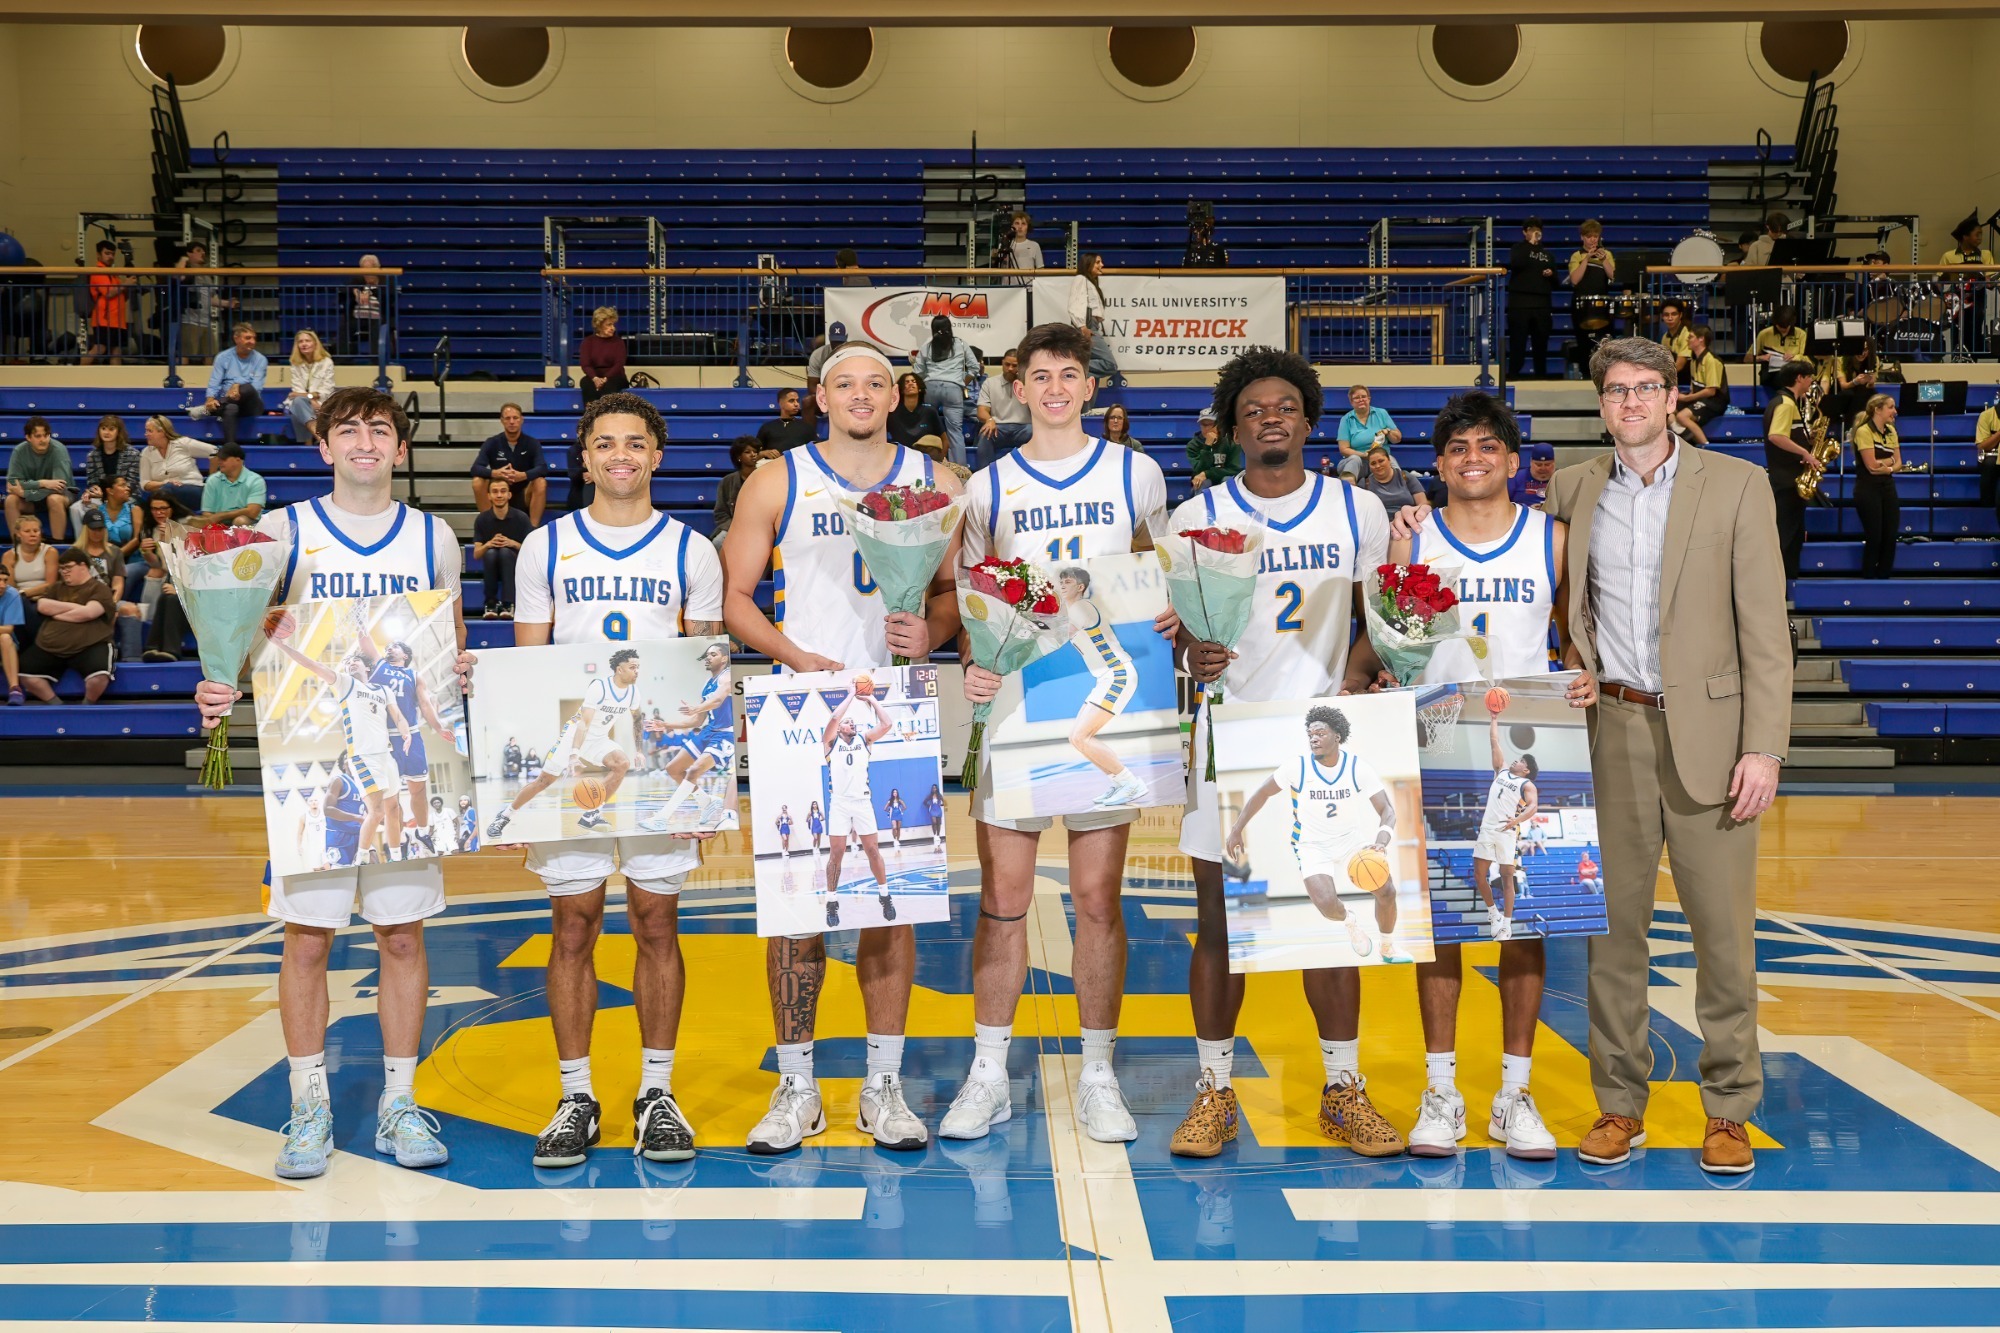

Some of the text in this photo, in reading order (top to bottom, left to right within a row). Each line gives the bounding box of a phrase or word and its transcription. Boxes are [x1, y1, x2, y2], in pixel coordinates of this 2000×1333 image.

[919, 291, 989, 319] MCA
[1104, 297, 1248, 308] ULL SAIL UNIVERSITY'S
[1133, 319, 1249, 338] PATRICK
[1117, 345, 1131, 354] OF
[1012, 501, 1114, 534] ROLLINS
[1046, 534, 1083, 561] 11
[310, 572, 419, 599] ROLLINS
[562, 575, 672, 606] ROLLINS
[1460, 577, 1536, 604] LLINS
[1275, 580, 1304, 633] 2
[601, 610, 631, 642] 9
[1472, 611, 1489, 637] 1
[924, 681, 937, 697] 19
[368, 702, 378, 714] 3
[846, 753, 854, 766] 0
[1309, 788, 1351, 800] ROLLINS
[1325, 802, 1338, 818] 2
